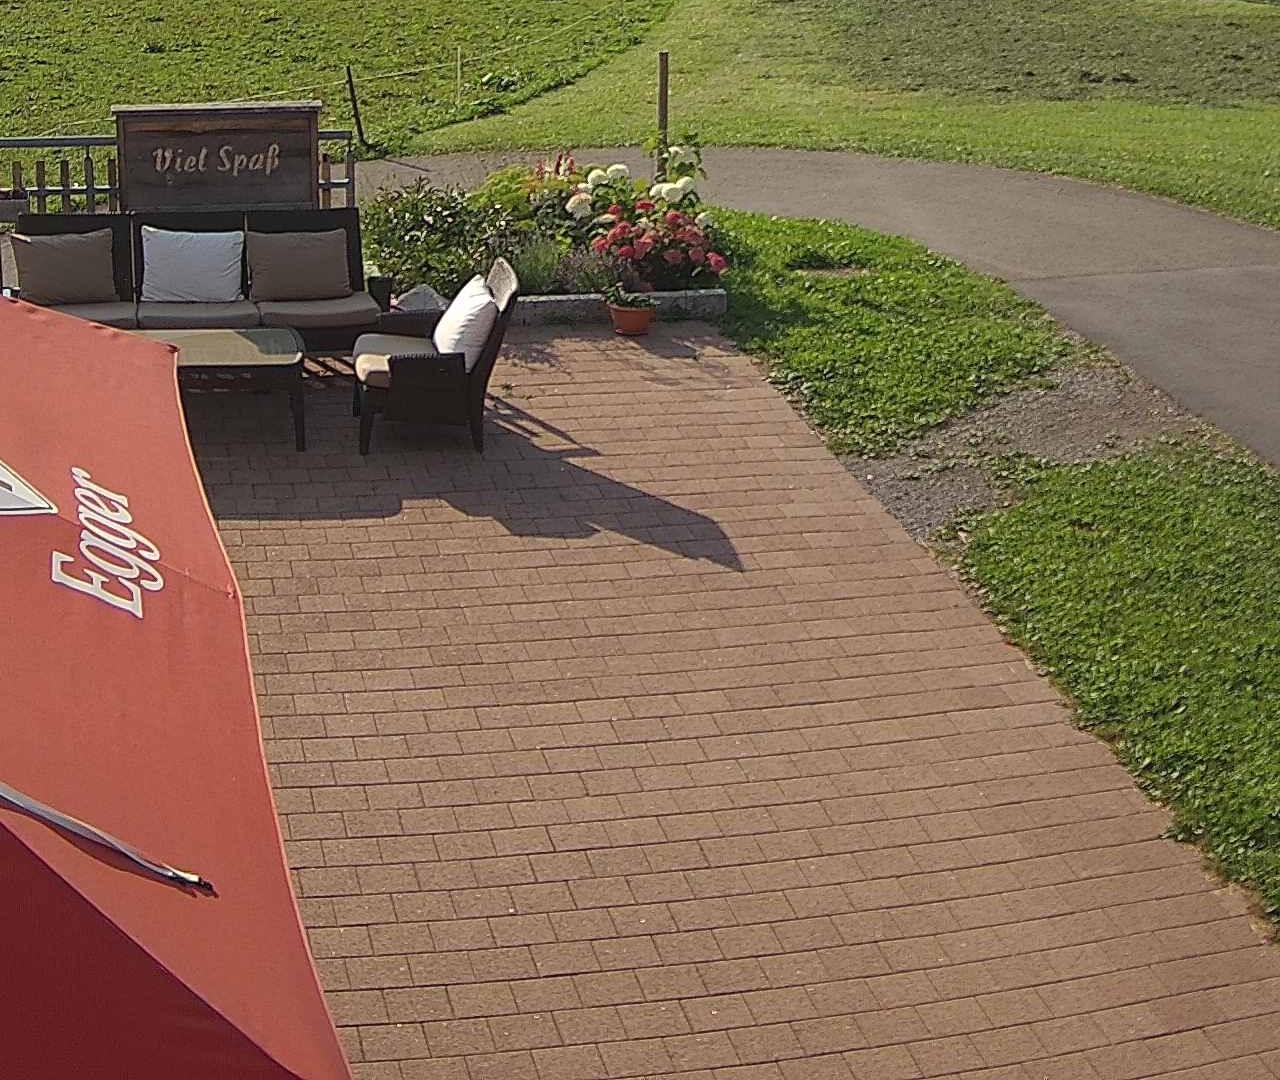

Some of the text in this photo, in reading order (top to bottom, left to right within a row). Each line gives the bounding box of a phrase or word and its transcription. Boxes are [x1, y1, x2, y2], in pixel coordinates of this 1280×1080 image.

[153, 143, 280, 176] Viel Spaß
[51, 467, 164, 619] Egger
